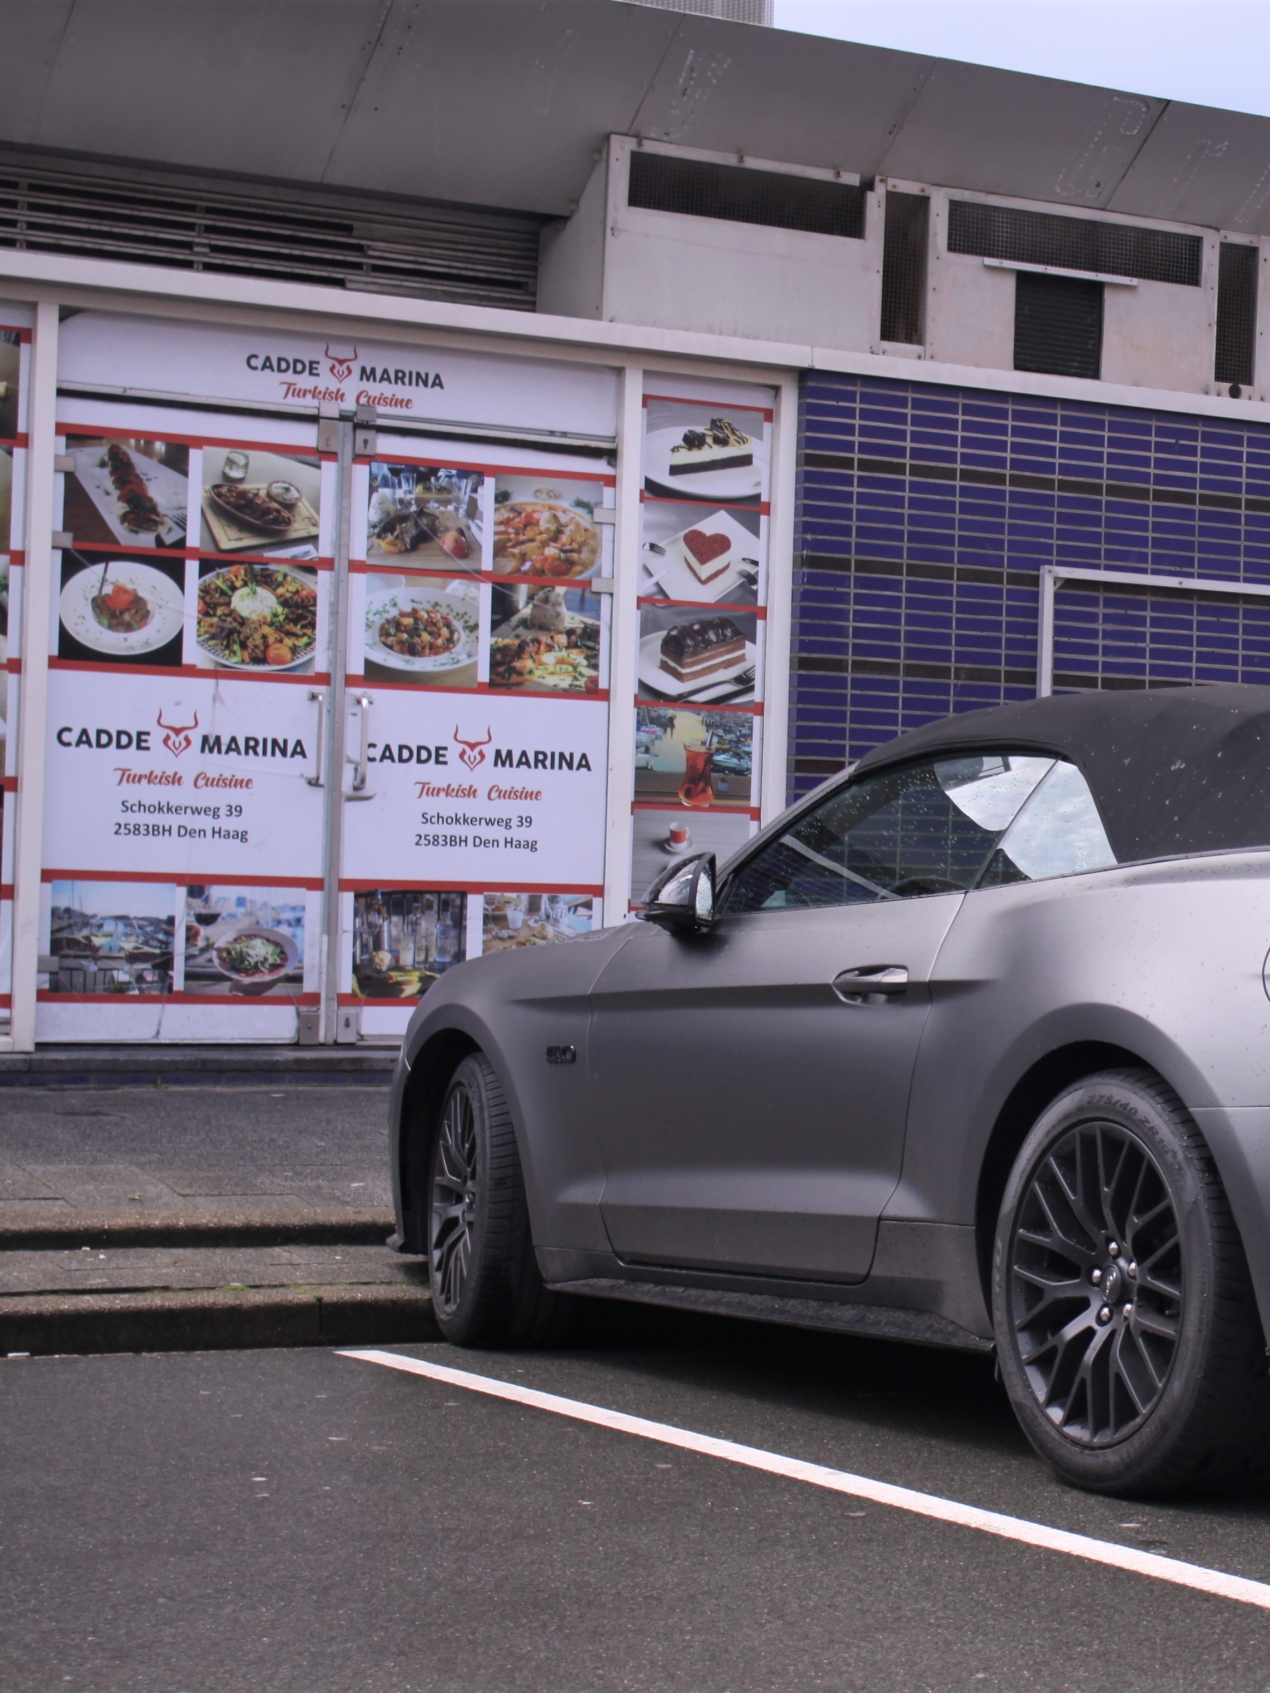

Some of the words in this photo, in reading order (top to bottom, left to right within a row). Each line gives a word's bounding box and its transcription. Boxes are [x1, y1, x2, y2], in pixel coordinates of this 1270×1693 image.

[246, 354, 321, 377] CADDE
[359, 365, 445, 390] MARINA
[279, 381, 346, 403] Turkish
[356, 389, 414, 410] Cuisine
[56, 726, 151, 751] CADDE
[199, 734, 308, 760] MARINA
[367, 742, 449, 765] CADDE
[493, 748, 592, 772] MARINA
[113, 767, 184, 787] Turkish
[193, 771, 254, 790] Cuisine
[413, 781, 478, 800] Turkish
[487, 784, 543, 802] Cuisine
[120, 800, 221, 820] Schokkerweg
[225, 804, 243, 818] 39
[113, 822, 173, 838] 2583BH
[177, 825, 207, 840] Den
[211, 826, 249, 843] Haag
[421, 812, 513, 831] Schokkerweg
[516, 815, 533, 829] 39
[414, 833, 468, 848] 2583BH
[472, 834, 500, 849] Den
[504, 836, 539, 853] Haag
